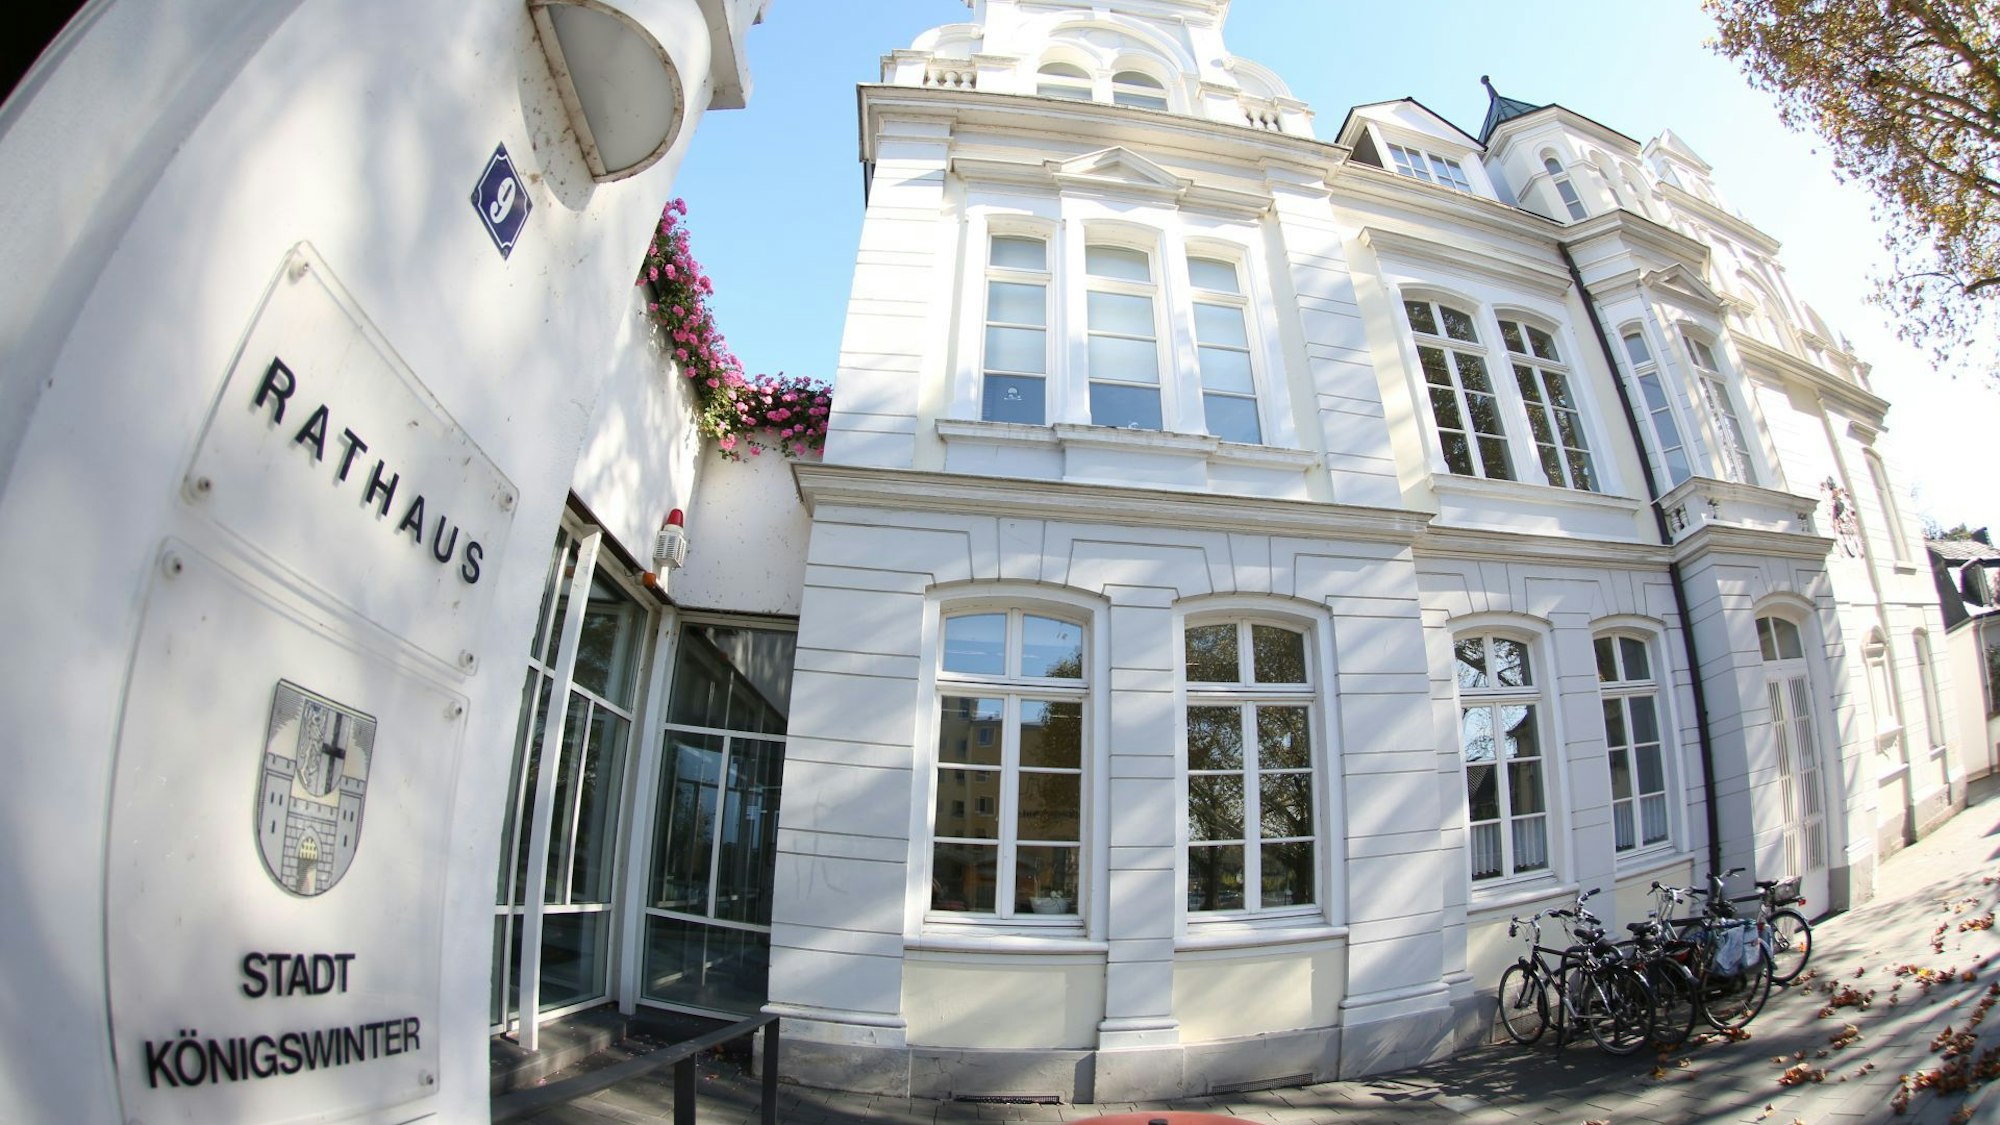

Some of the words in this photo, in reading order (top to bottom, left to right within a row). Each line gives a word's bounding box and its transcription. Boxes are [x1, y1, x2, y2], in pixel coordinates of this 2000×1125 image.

[490, 177, 516, 224] 9
[254, 355, 484, 584] RATHAUS
[242, 952, 356, 998] STADT
[145, 1016, 421, 1089] KÖNIGSWINTER
